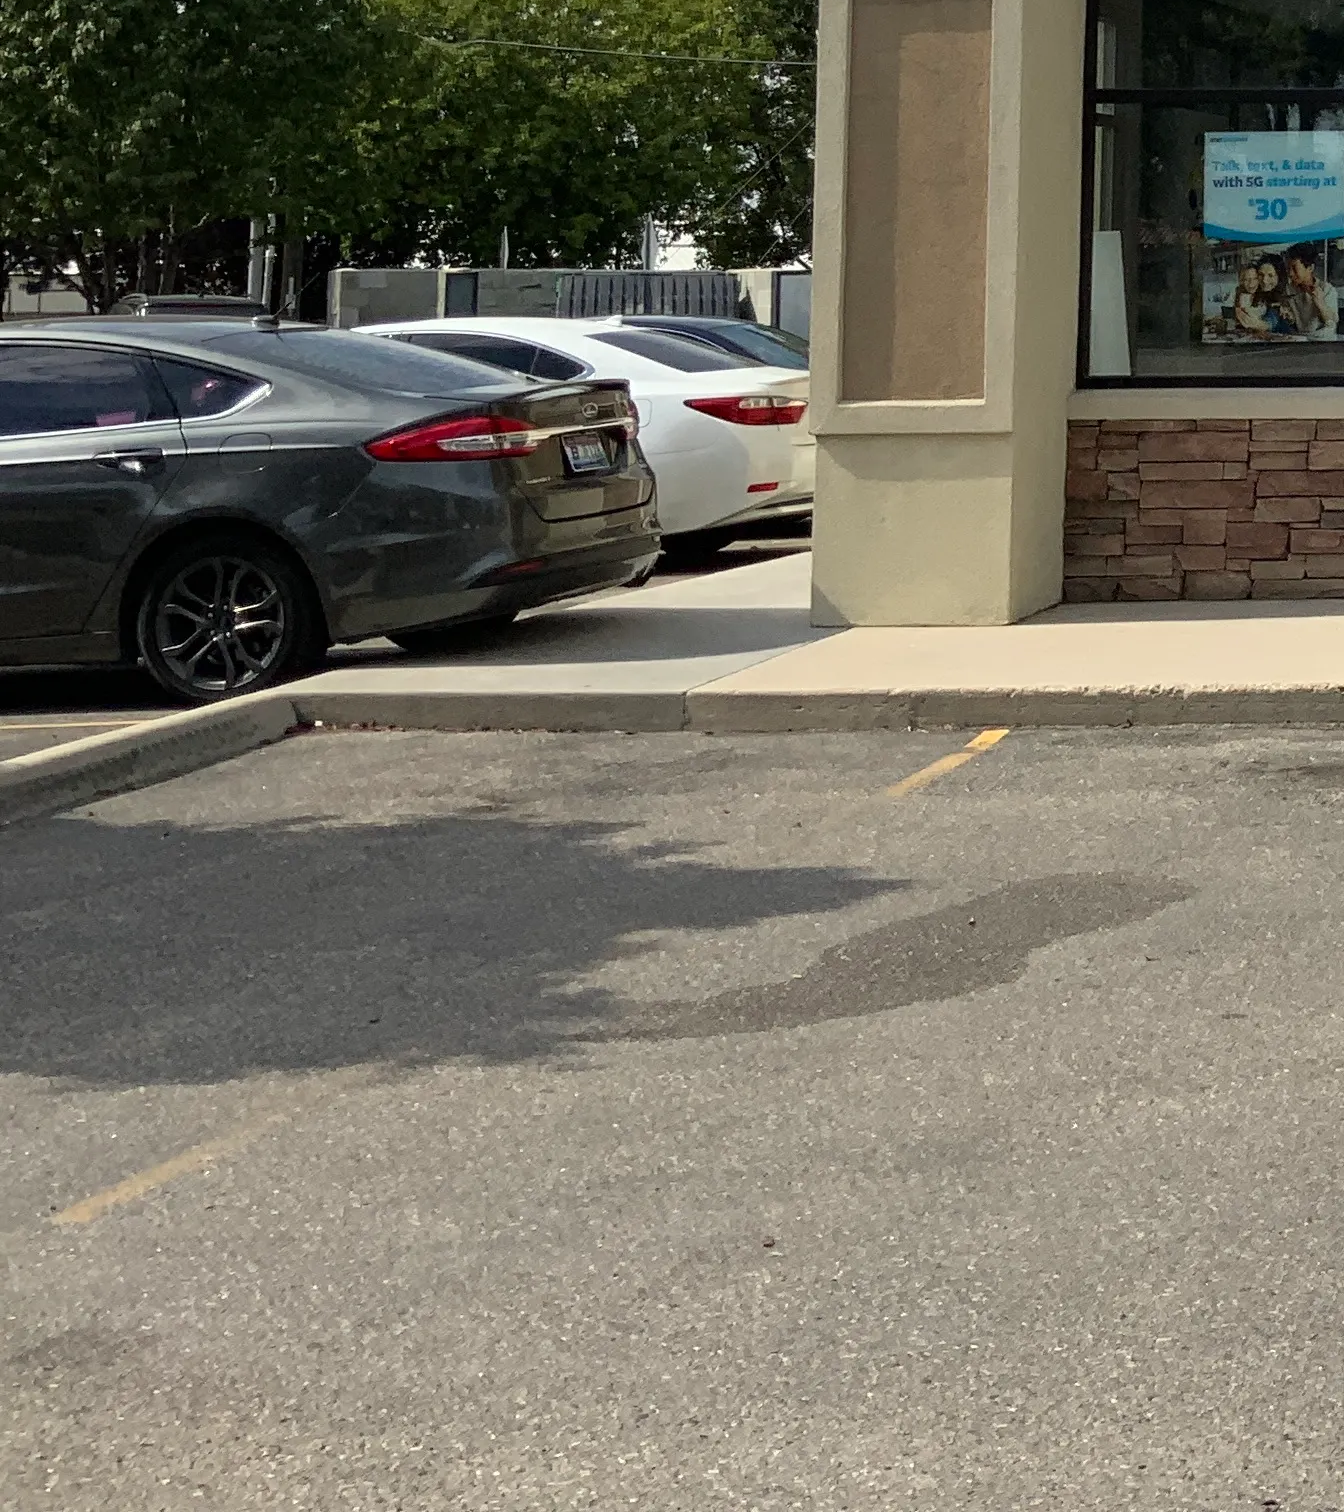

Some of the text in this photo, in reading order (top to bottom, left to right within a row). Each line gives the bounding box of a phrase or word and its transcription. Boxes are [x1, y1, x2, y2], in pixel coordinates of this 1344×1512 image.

[1281, 159, 1292, 170] &
[1295, 157, 1325, 171] data
[1212, 175, 1337, 190] with 5G starting at
